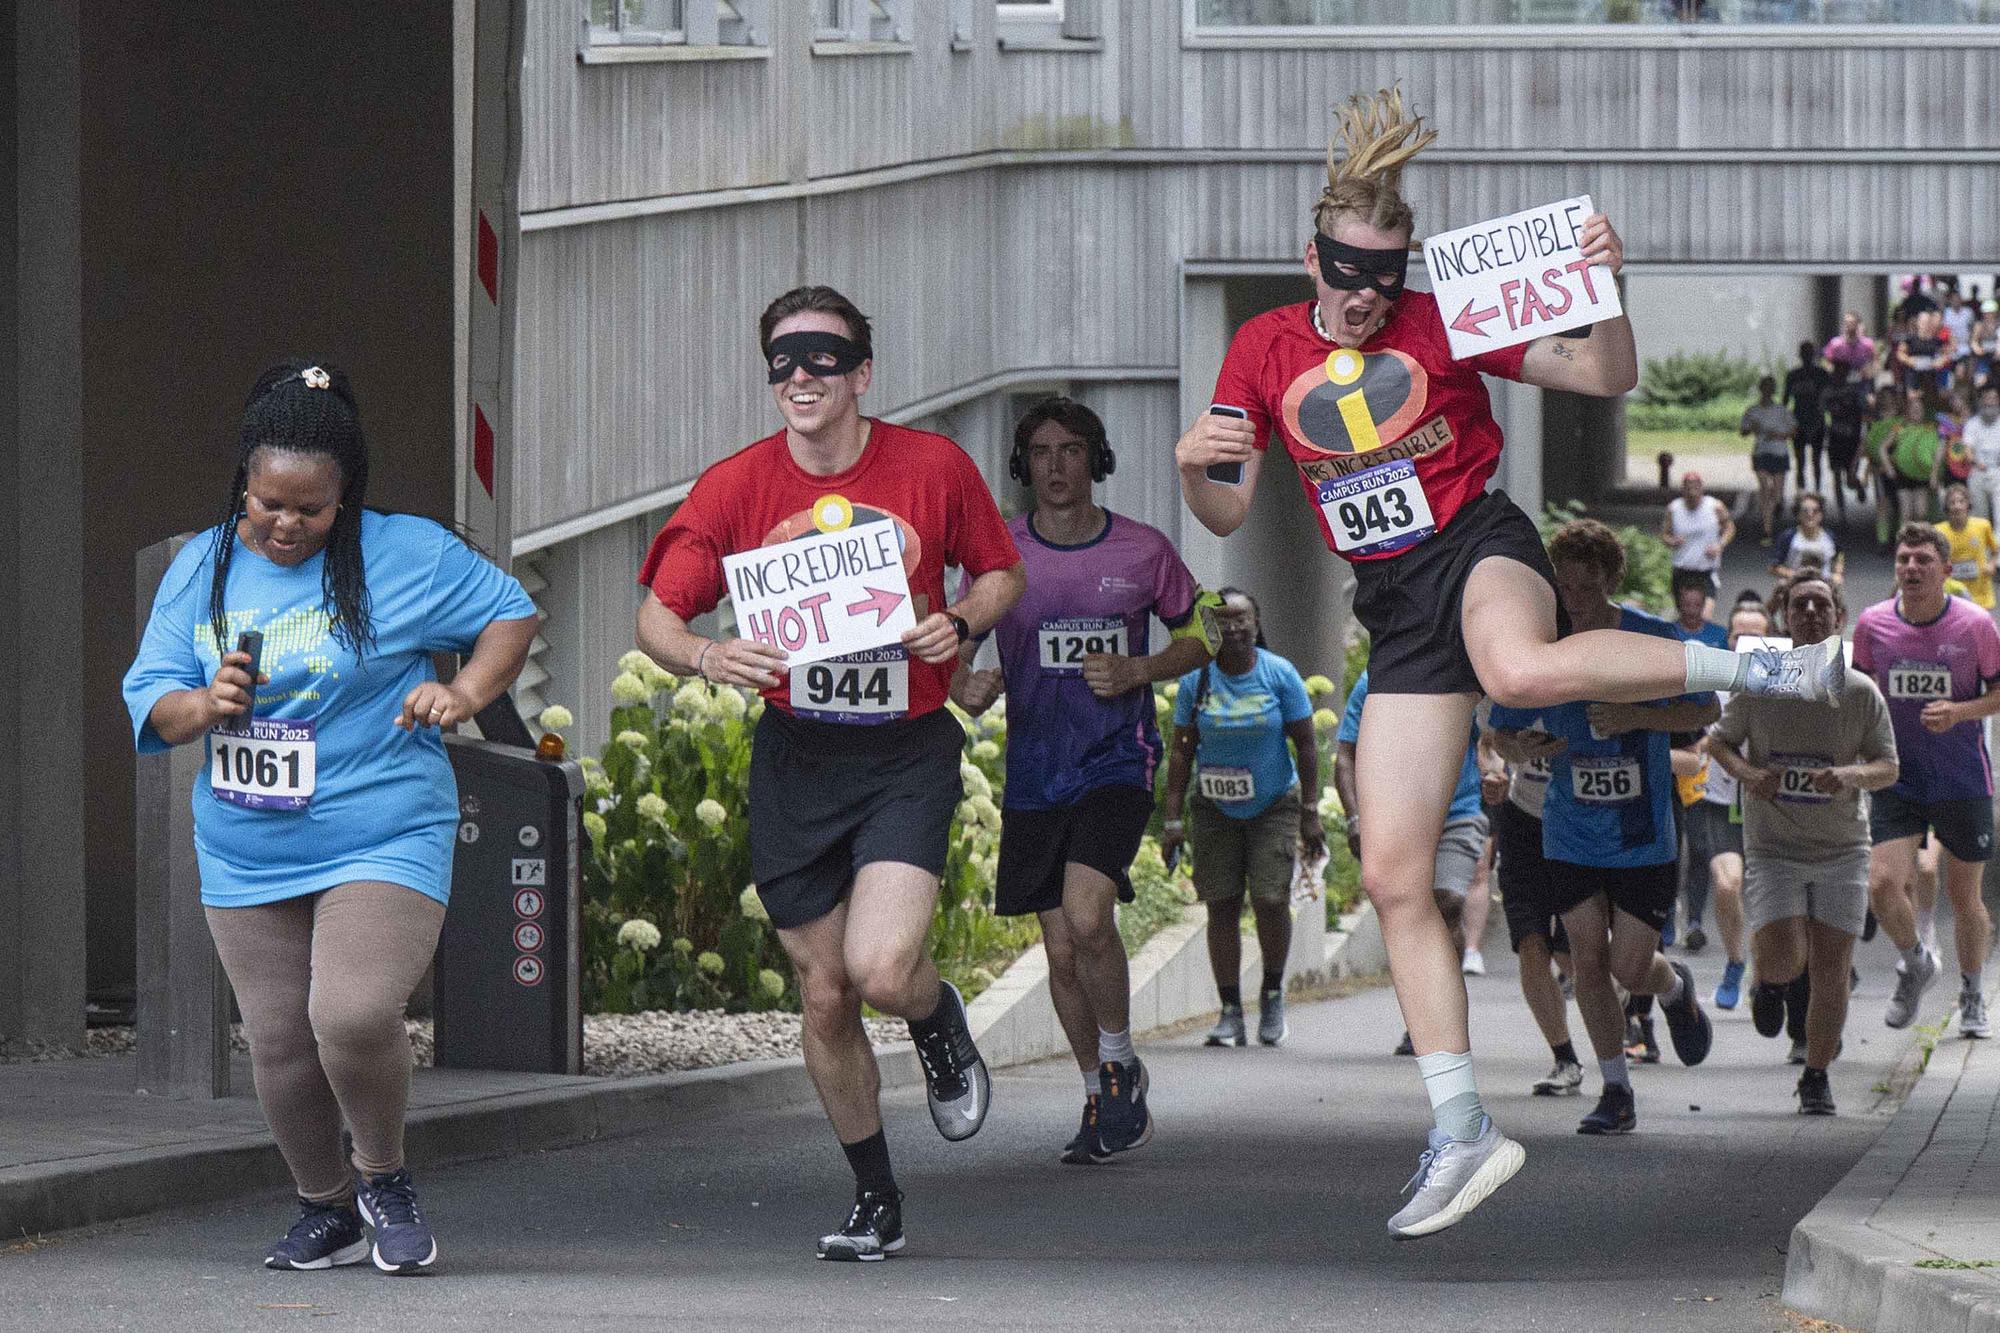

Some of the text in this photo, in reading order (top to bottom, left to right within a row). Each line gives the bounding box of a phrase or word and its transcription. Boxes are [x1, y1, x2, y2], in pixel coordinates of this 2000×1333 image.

[1430, 205, 1582, 281] INCREDIBLE
[1499, 258, 1599, 331] FAST
[1321, 467, 1410, 502] CAMPUS RUN 2025
[1339, 487, 1414, 541] 943
[735, 530, 897, 601] INCREDIBLE
[748, 592, 832, 651] HOT
[1042, 621, 1081, 631] CAMPUS
[1082, 622, 1103, 631] RUN
[847, 651, 873, 662] RUN
[876, 650, 903, 661] 2025
[1047, 634, 1119, 663] 1291
[806, 665, 892, 706] 944
[1894, 674, 1946, 694] 1824
[253, 729, 278, 740] RUN
[281, 729, 309, 740] 2025
[216, 744, 299, 788] 1061
[1579, 770, 1631, 796] 256
[1205, 778, 1250, 797] 1083
